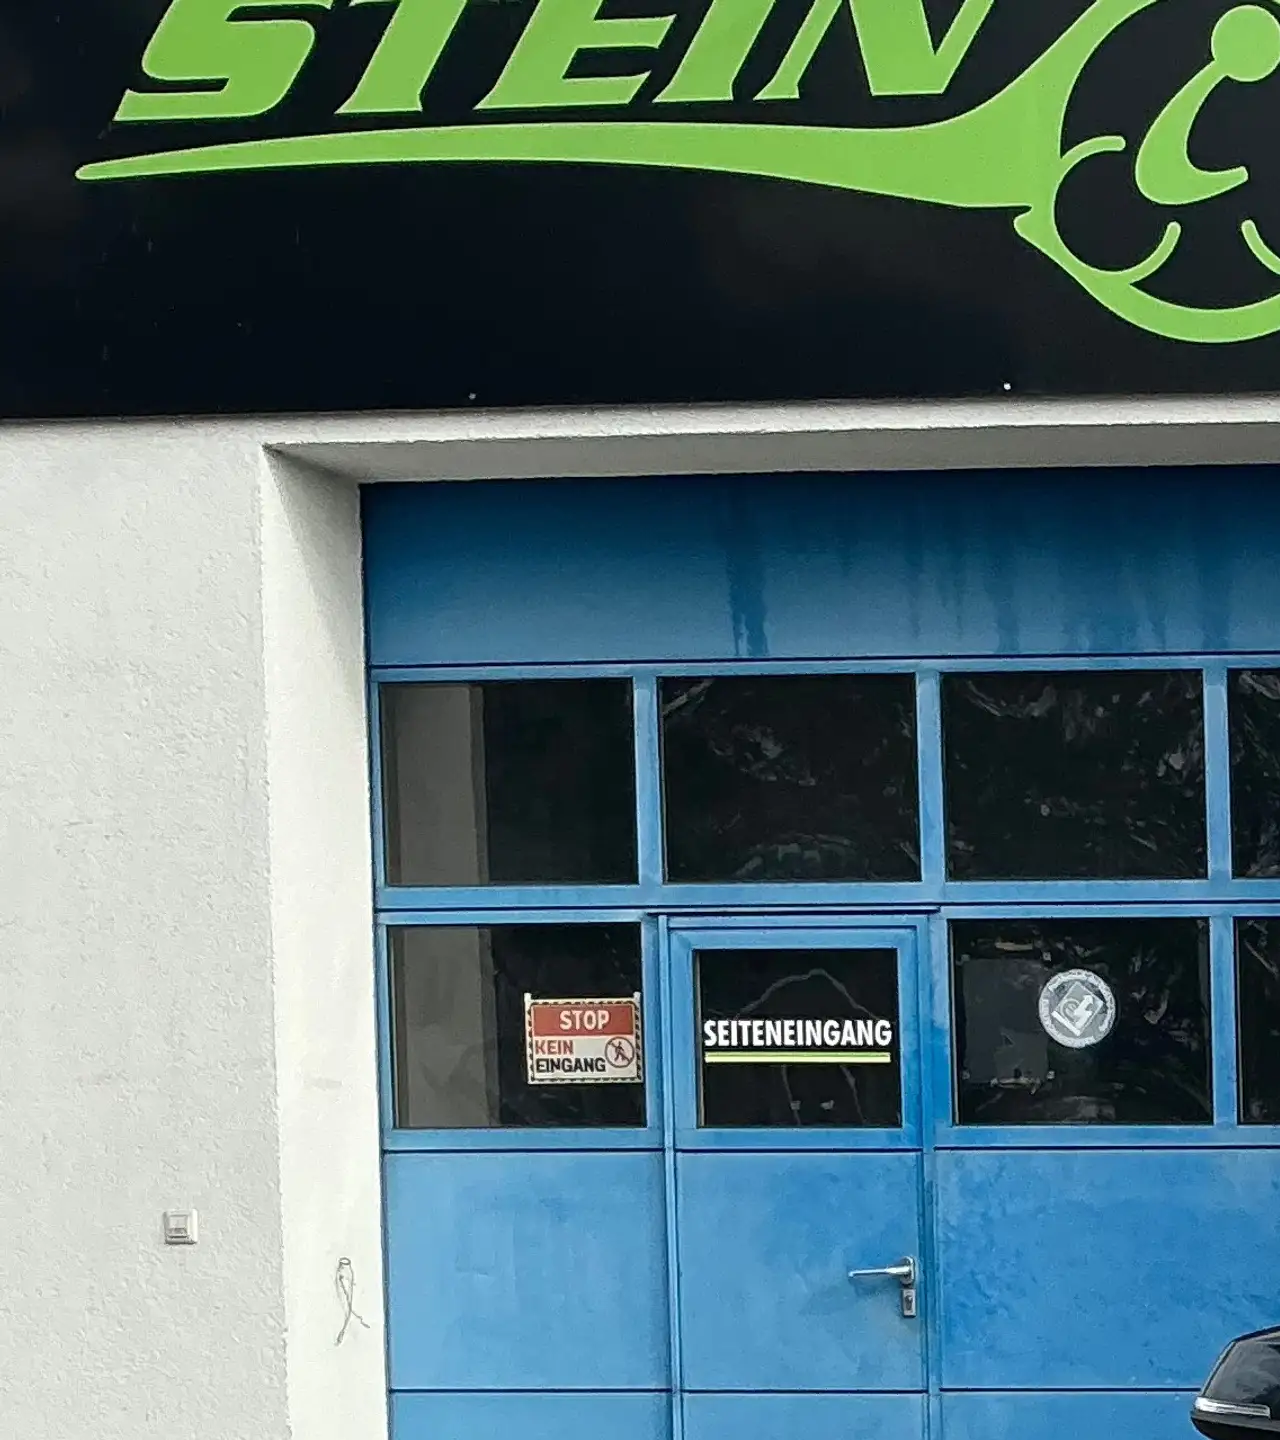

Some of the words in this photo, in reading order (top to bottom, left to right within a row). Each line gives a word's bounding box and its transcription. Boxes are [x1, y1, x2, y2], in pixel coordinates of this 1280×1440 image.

[559, 1009, 610, 1031] STOP
[703, 1019, 892, 1047] SEITENEINGANG
[535, 1040, 574, 1055] KEIN
[536, 1057, 606, 1073] EINGANG
